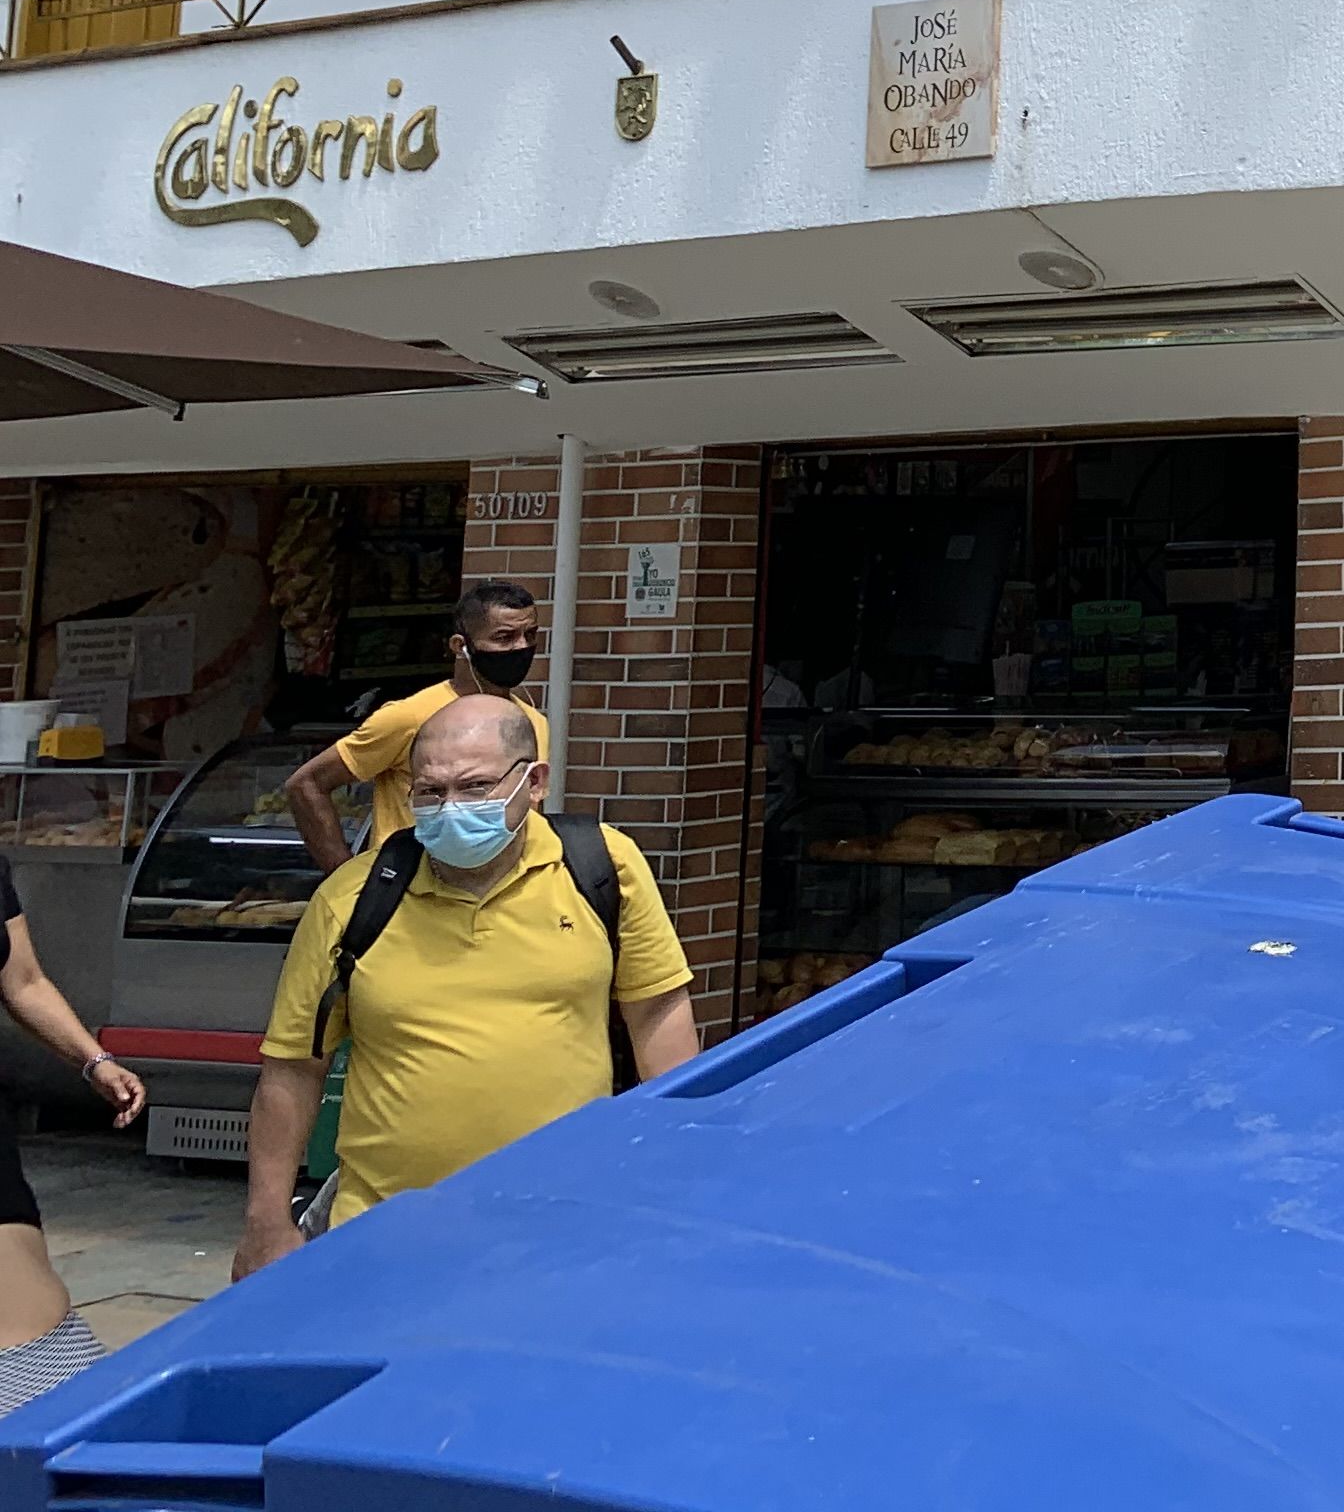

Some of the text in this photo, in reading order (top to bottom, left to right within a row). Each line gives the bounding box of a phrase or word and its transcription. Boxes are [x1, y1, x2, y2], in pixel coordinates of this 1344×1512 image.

[884, 78, 976, 112] OBANDO
[889, 122, 969, 154] CALLE 49
[154, 76, 439, 248] California
